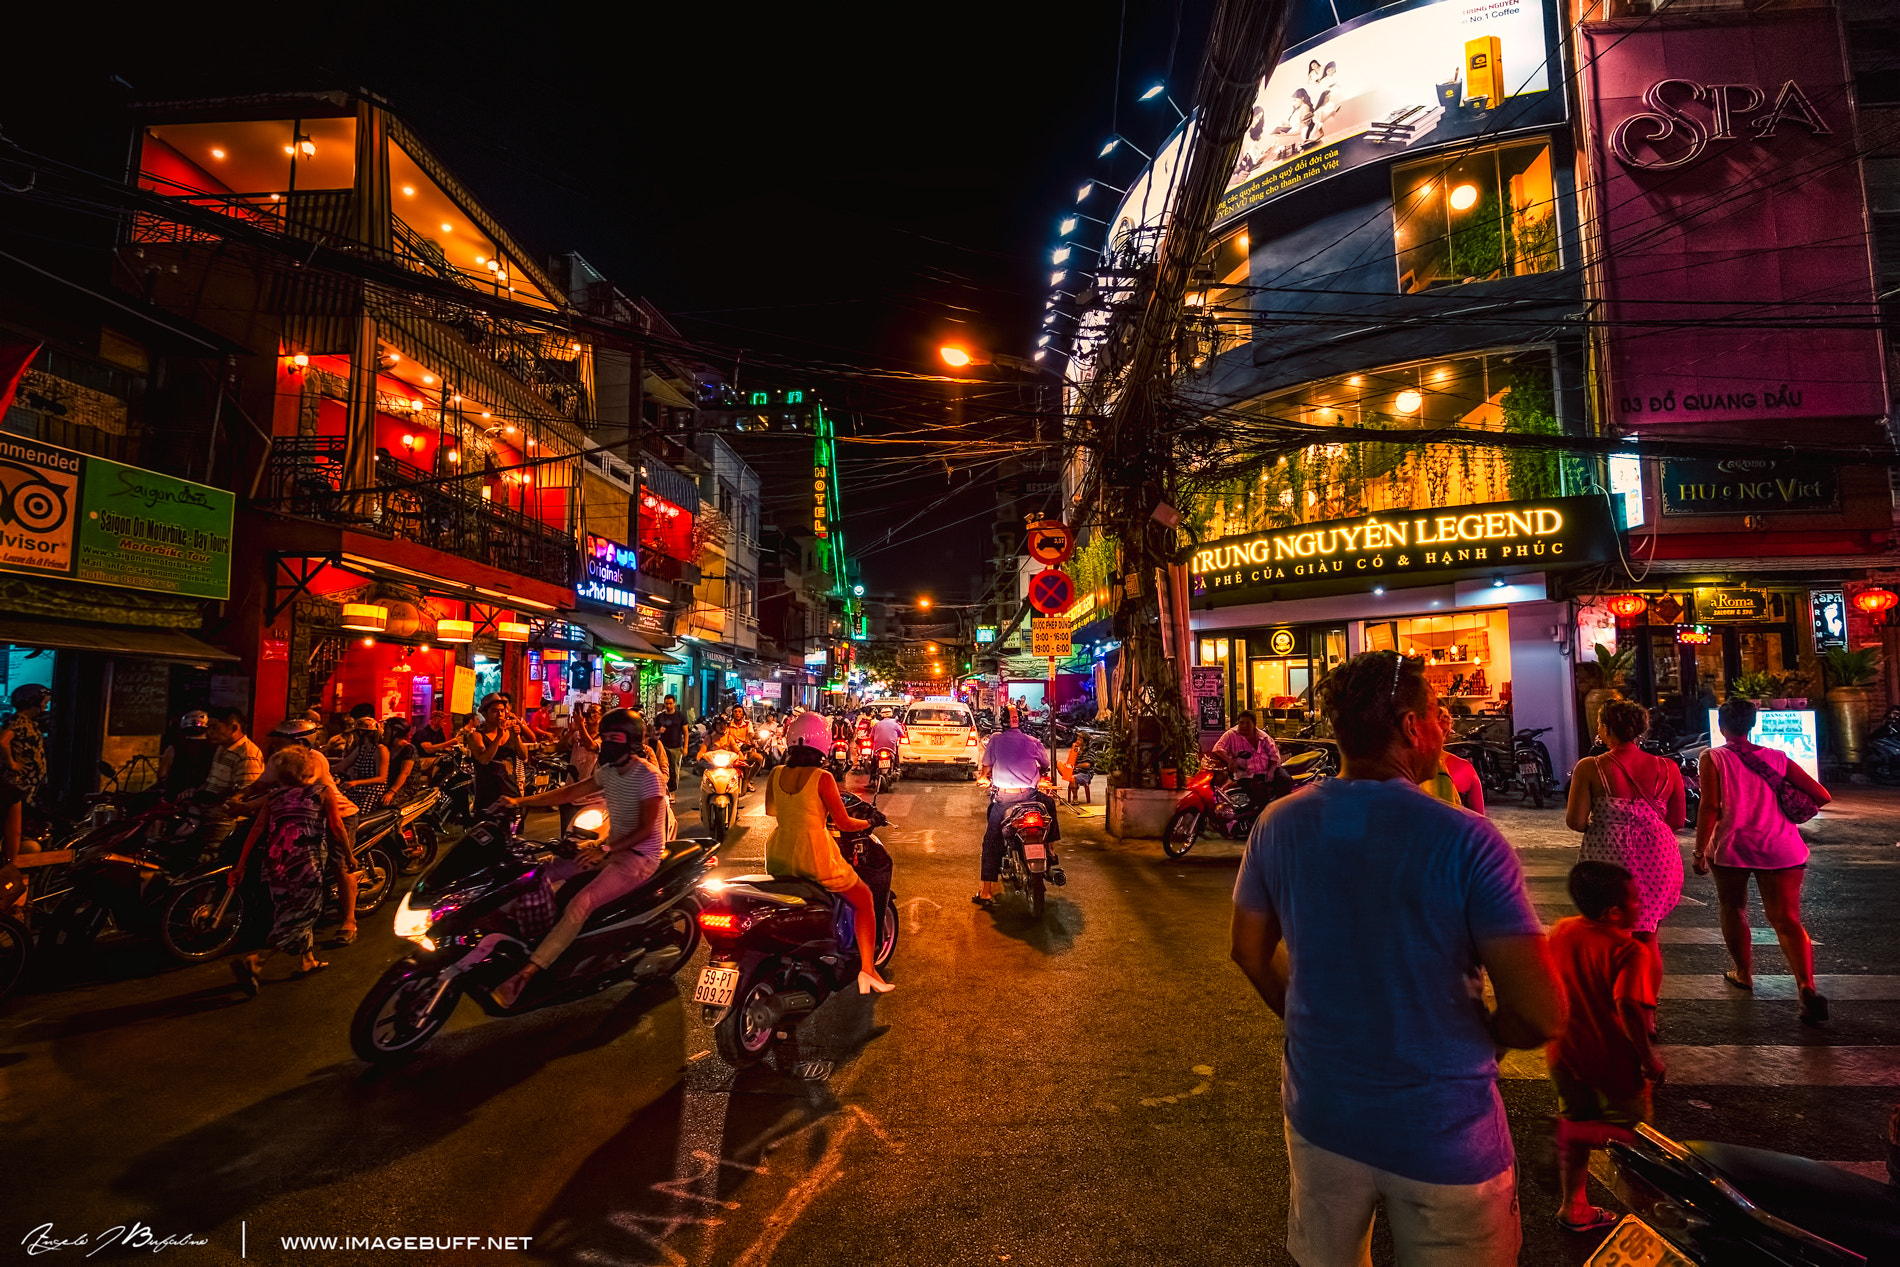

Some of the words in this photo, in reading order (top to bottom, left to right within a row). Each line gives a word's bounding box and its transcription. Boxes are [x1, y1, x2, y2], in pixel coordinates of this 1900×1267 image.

[1491, 8, 1519, 18] Coffee
[1608, 78, 1833, 171] SPA
[1227, 194, 1238, 204] các
[1261, 174, 1277, 186] sách
[1324, 150, 1339, 160] của
[1265, 185, 1279, 195] cho
[1280, 176, 1301, 189] thanh
[1303, 168, 1320, 179] niên
[1322, 160, 1339, 171] Việt
[1683, 392, 1757, 410] QUANG
[814, 467, 826, 531] HOTEL
[100, 510, 131, 536] Saigon
[133, 517, 145, 538] On
[146, 518, 187, 546] Motorbike
[193, 529, 209, 552] Day
[209, 532, 229, 554] Tours
[1193, 540, 1271, 574] TRUNG
[1274, 518, 1408, 560] NGUYÊN
[1415, 509, 1563, 544] LEGEND
[119, 539, 184, 558] Motorbike
[187, 551, 212, 563] Tour
[43, 558, 68, 570] Friend
[589, 559, 624, 583] Originals
[1214, 571, 1243, 587] PHÊ
[1251, 566, 1285, 582] CỦA
[1294, 558, 1344, 577] GIÀU
[1356, 553, 1384, 570] CÓ
[1397, 555, 1410, 566] &
[1425, 548, 1488, 564] HẠNH
[1502, 538, 1564, 558] PHÚC
[1819, 593, 1843, 603] SPA
[1035, 633, 1049, 641] 9:00
[1053, 632, 1069, 641] 16:00
[1680, 633, 1708, 643] OPEN
[1034, 644, 1050, 653] 19:00
[1056, 644, 1069, 653] 6:00
[703, 969, 732, 987] 59-P1
[695, 985, 733, 1004] 909.27
